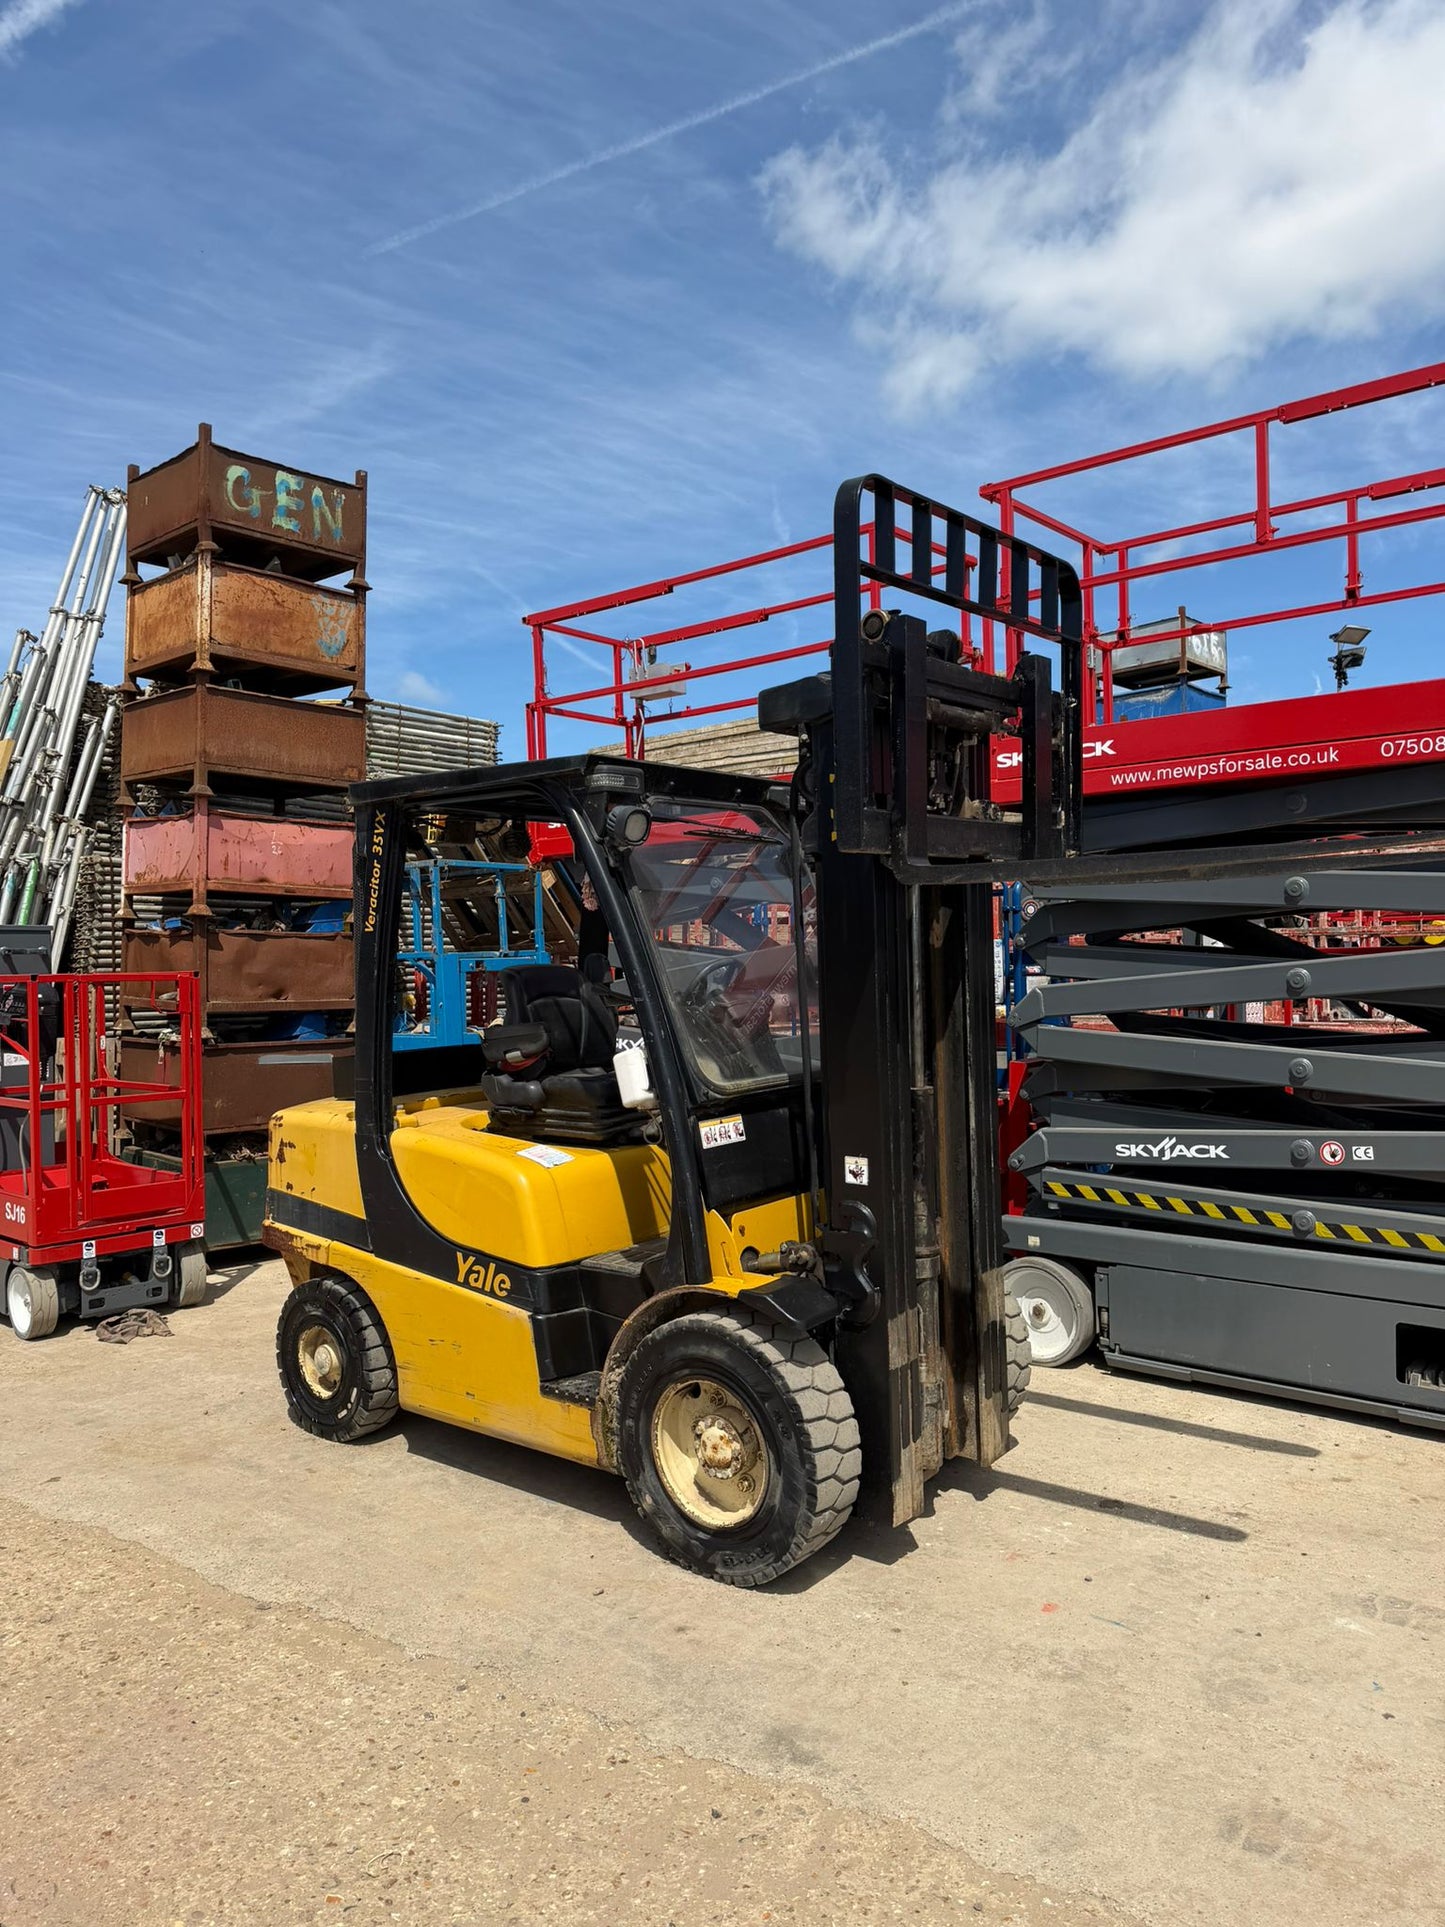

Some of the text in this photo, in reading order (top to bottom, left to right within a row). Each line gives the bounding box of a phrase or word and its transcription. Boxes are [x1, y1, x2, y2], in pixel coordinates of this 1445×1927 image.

[224, 465, 346, 544] GEN
[1381, 736, 1445, 757] 07508
[1111, 747, 1339, 785] www.mewpsforsale.co.uk
[364, 809, 386, 932] Veracitor 35VX
[1115, 1136, 1231, 1161] SKYJACK
[1354, 1147, 1373, 1159] CE
[5, 1202, 26, 1225] SJ16
[456, 1251, 511, 1297] Yale
